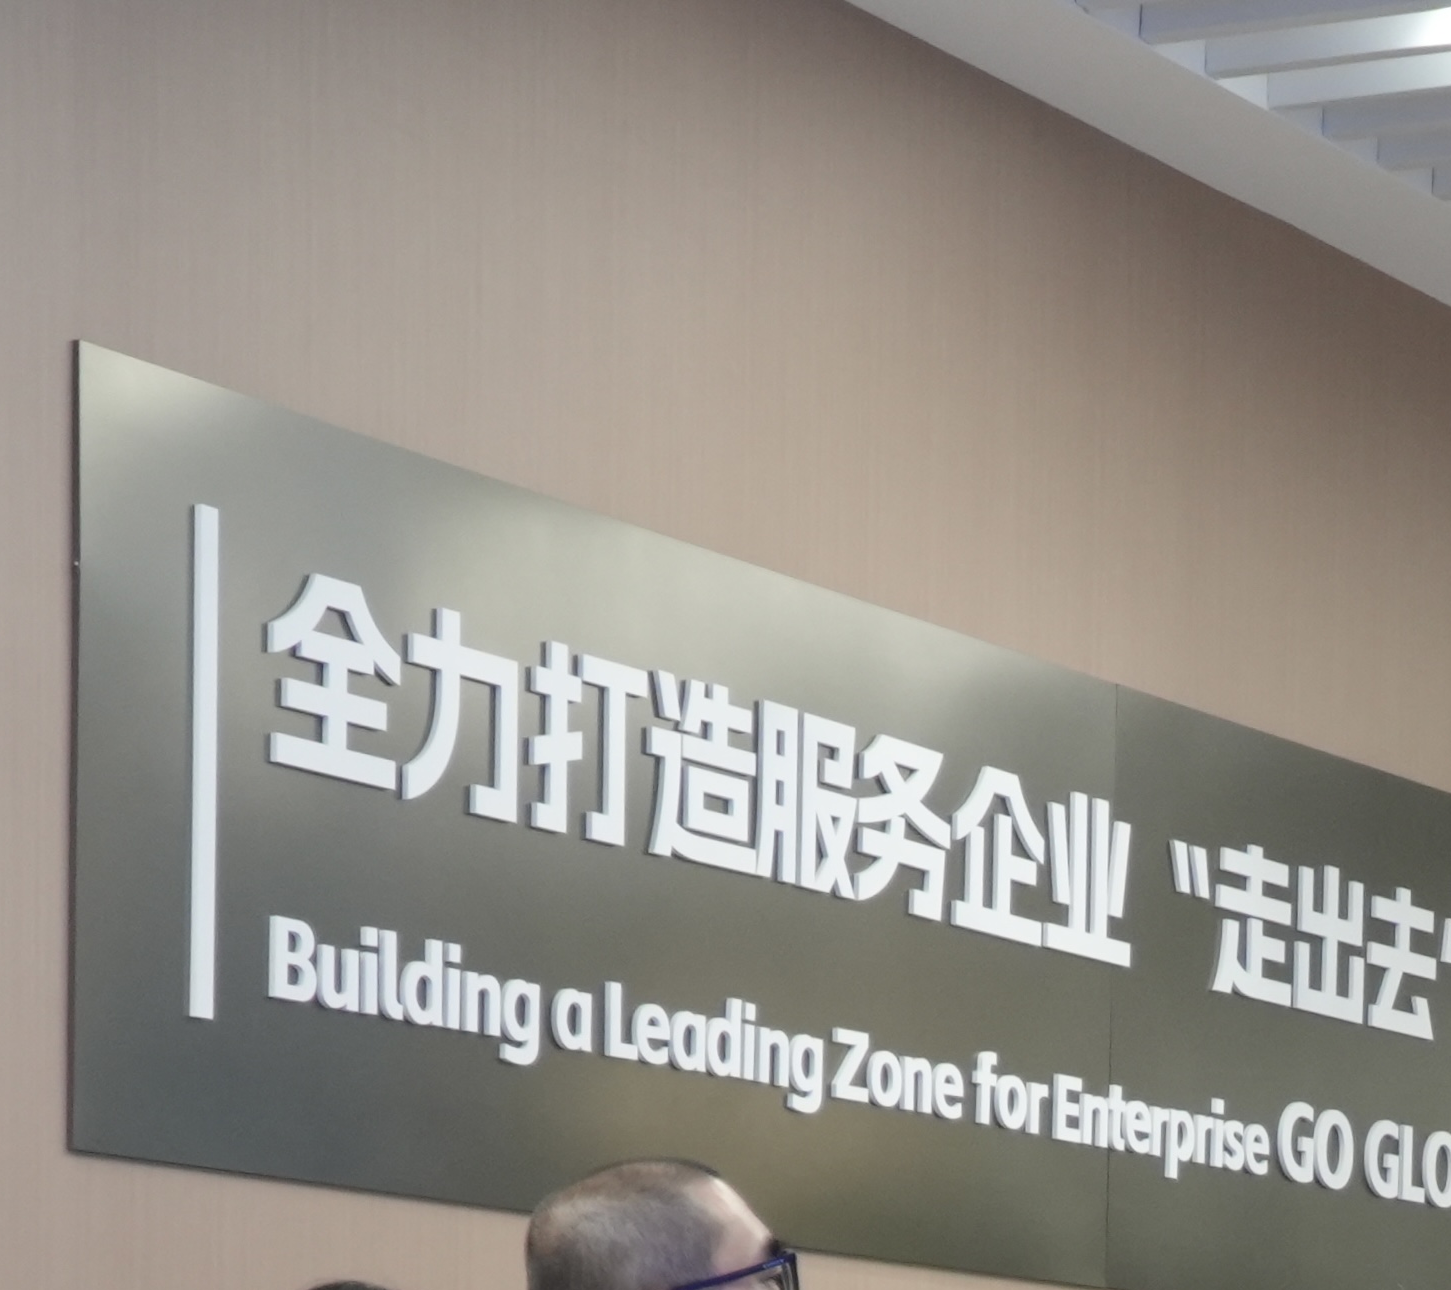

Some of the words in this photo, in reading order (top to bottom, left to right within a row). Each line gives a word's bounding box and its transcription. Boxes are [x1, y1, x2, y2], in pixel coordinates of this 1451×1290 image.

[266, 914, 542, 1066] Building
[550, 989, 594, 1053] a
[604, 981, 825, 1113] Leading
[830, 1029, 965, 1121] Zone
[971, 1051, 1050, 1135] for
[1051, 1075, 1270, 1179] Enterprise
[1277, 1102, 1353, 1190] GO
